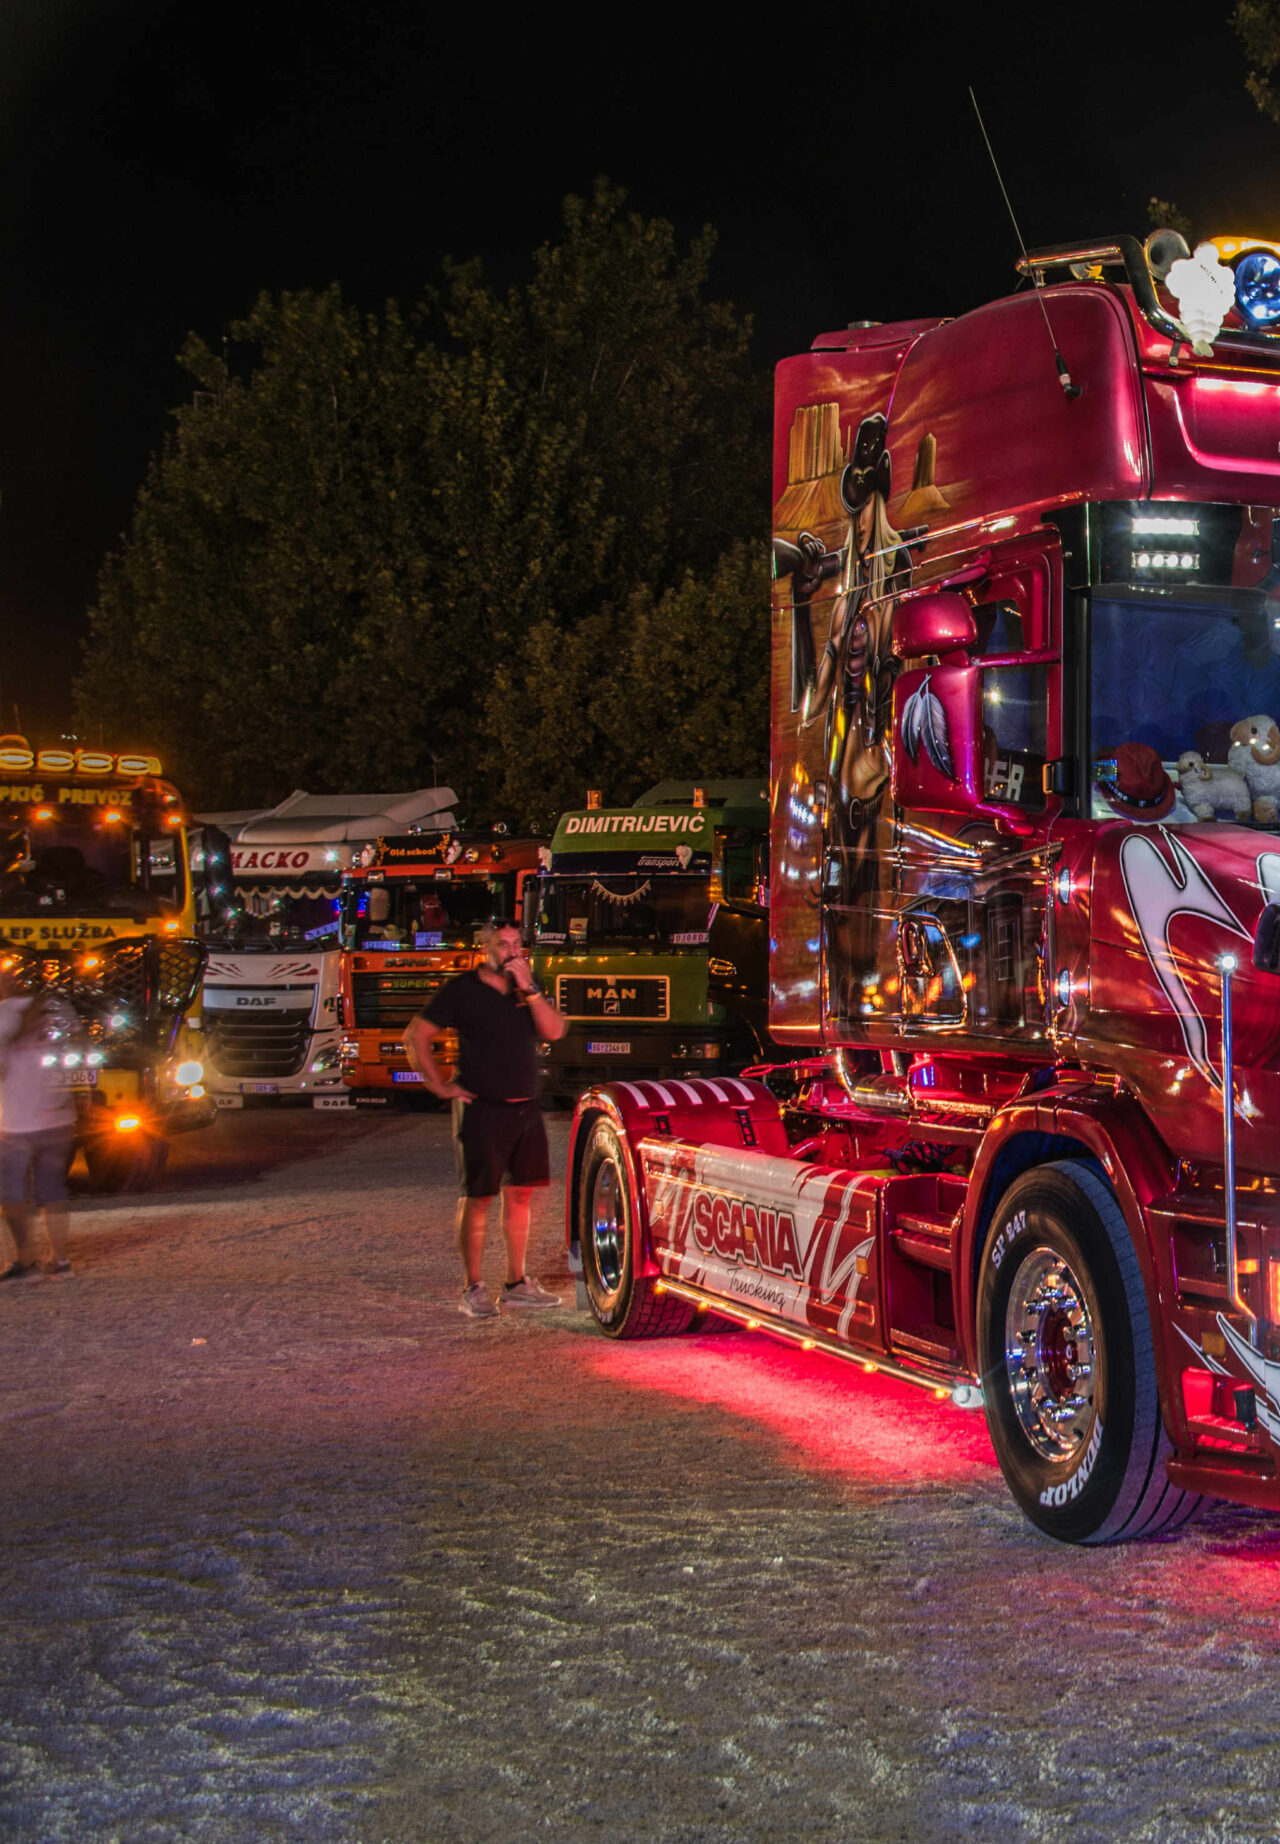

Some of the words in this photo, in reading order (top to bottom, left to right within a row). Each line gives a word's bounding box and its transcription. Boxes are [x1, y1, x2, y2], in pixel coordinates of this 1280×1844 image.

[59, 788, 132, 806] PREVOZ
[566, 812, 705, 834] DIMITRIJEVIĆ
[390, 848, 405, 856] Old
[406, 847, 436, 856] school
[40, 922, 117, 939] SLUŽBA
[236, 997, 277, 1006] DAF
[587, 987, 637, 999] MAN
[693, 1190, 804, 1282] SCANIA
[992, 1233, 1006, 1269] SP
[1006, 1210, 1027, 1242] 247
[727, 1267, 785, 1312] Trucking
[1040, 1412, 1103, 1507] DUNLOP
